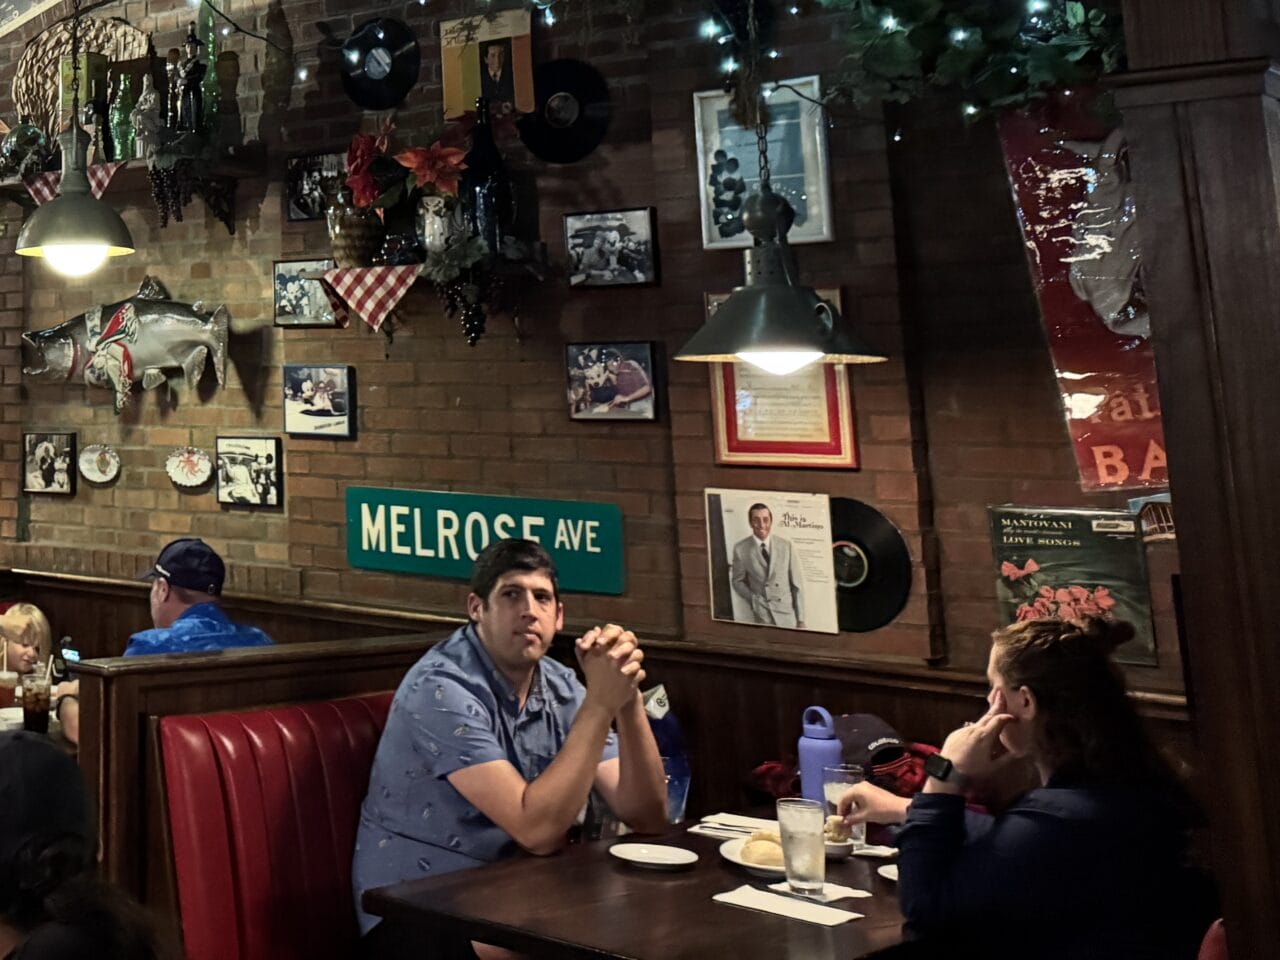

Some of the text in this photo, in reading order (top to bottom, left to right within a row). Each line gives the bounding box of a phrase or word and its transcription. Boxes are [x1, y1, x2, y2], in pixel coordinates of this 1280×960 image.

[1001, 518, 1073, 530] MANTOVANI
[554, 518, 602, 553] AVE
[1002, 535, 1081, 547] LOVE SONGS
